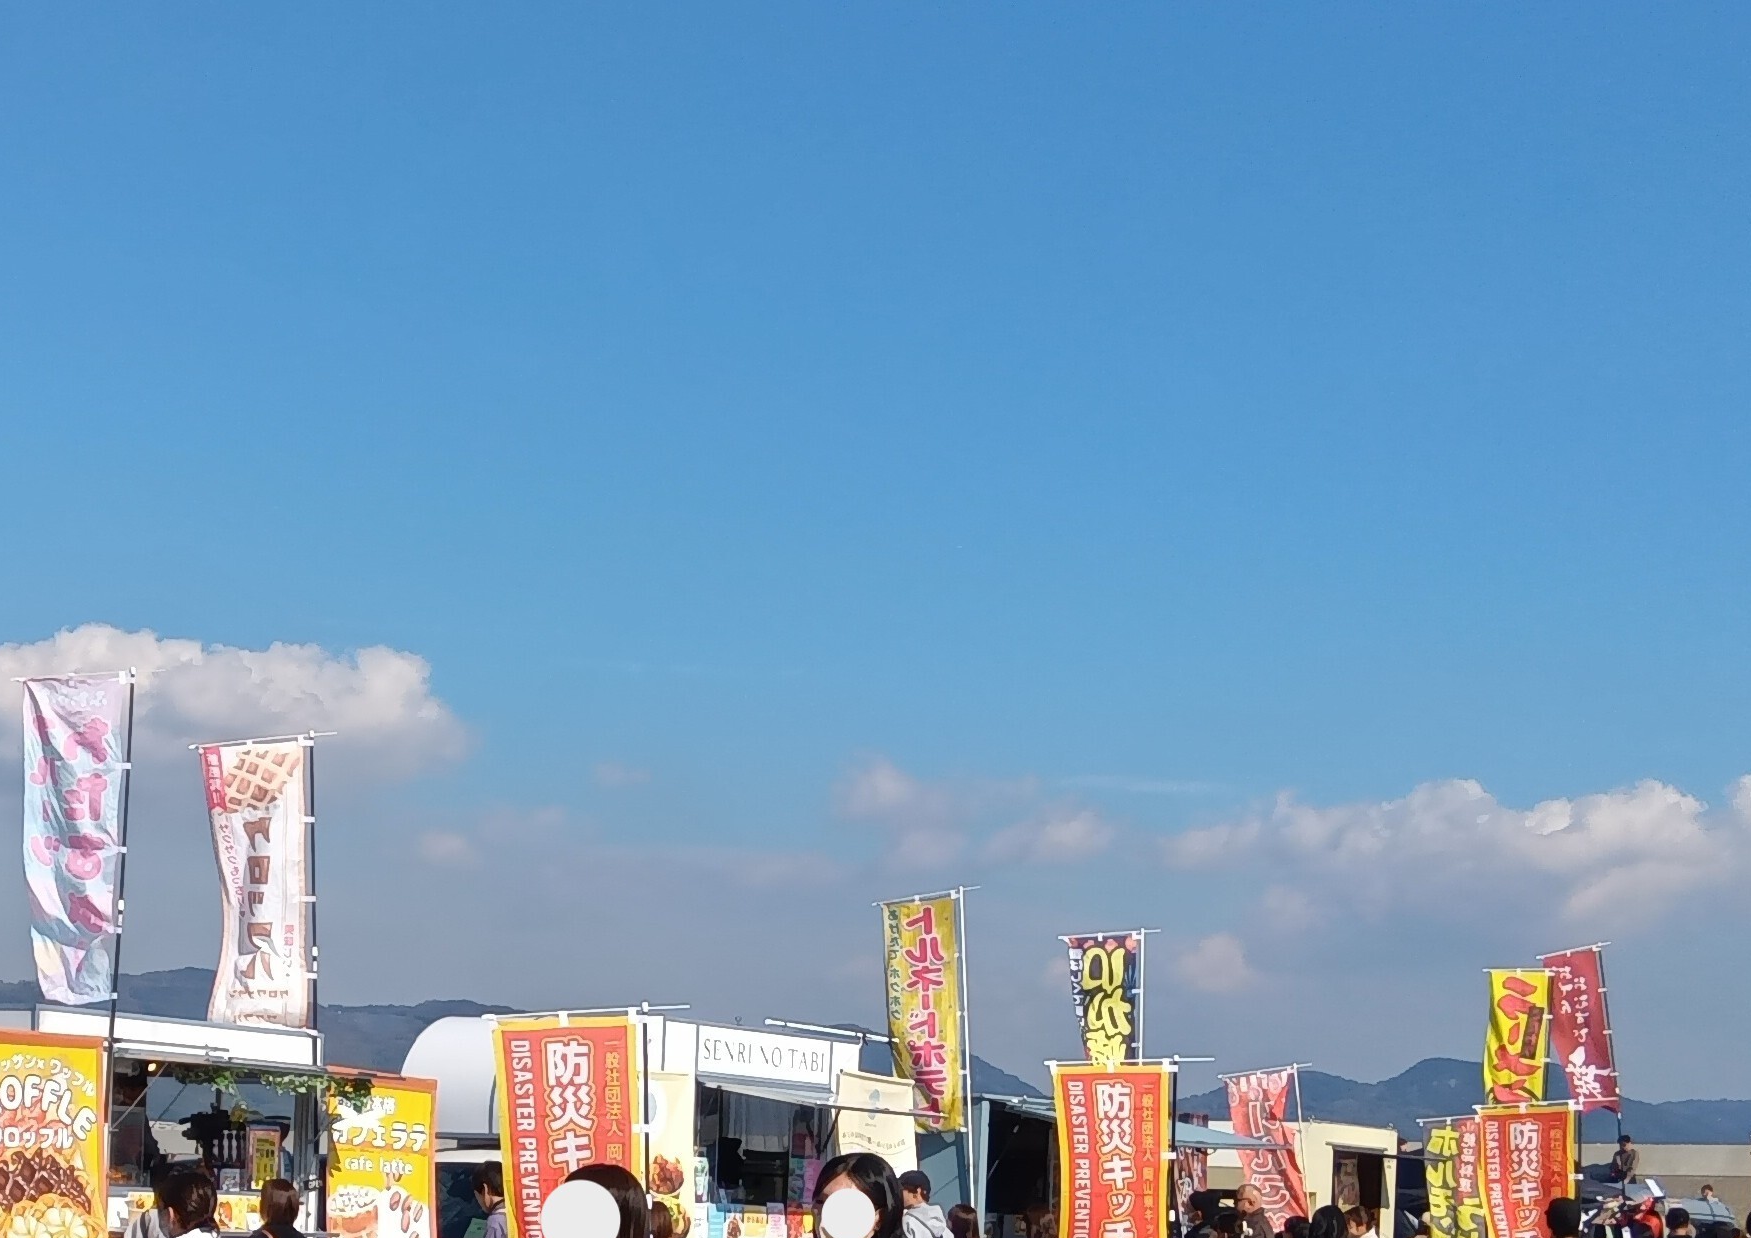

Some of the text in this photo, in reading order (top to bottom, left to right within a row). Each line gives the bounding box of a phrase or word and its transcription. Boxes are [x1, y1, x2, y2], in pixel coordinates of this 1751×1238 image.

[703, 1038, 752, 1064] SENRI
[788, 1048, 825, 1073] TABI
[510, 1040, 536, 1131] DISASTER
[1068, 1081, 1089, 1153] DISASTER
[345, 1156, 413, 1174] cafe latte
[1485, 1121, 1500, 1180] DISASTER
